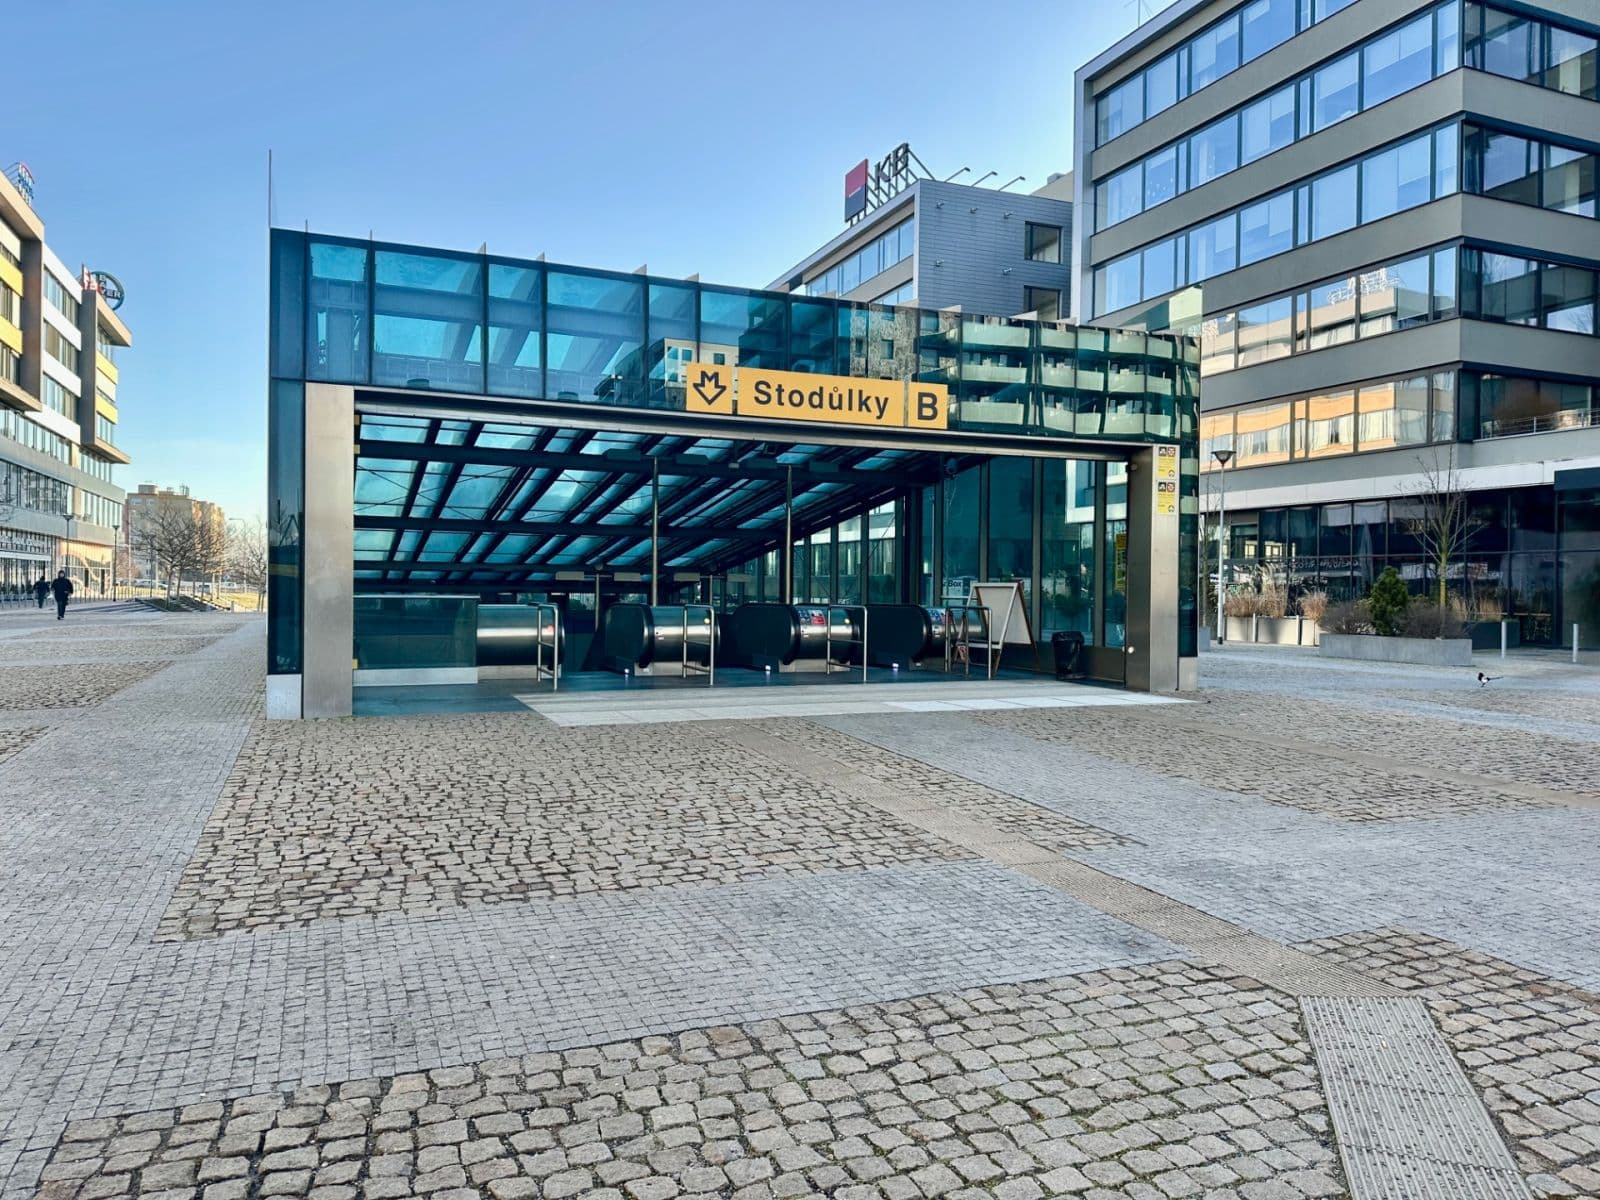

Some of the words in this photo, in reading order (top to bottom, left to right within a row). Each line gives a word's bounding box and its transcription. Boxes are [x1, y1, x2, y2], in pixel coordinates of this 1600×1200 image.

[874, 142, 909, 191] KB
[754, 380, 889, 419] Stodůlky
[917, 391, 939, 421] B
